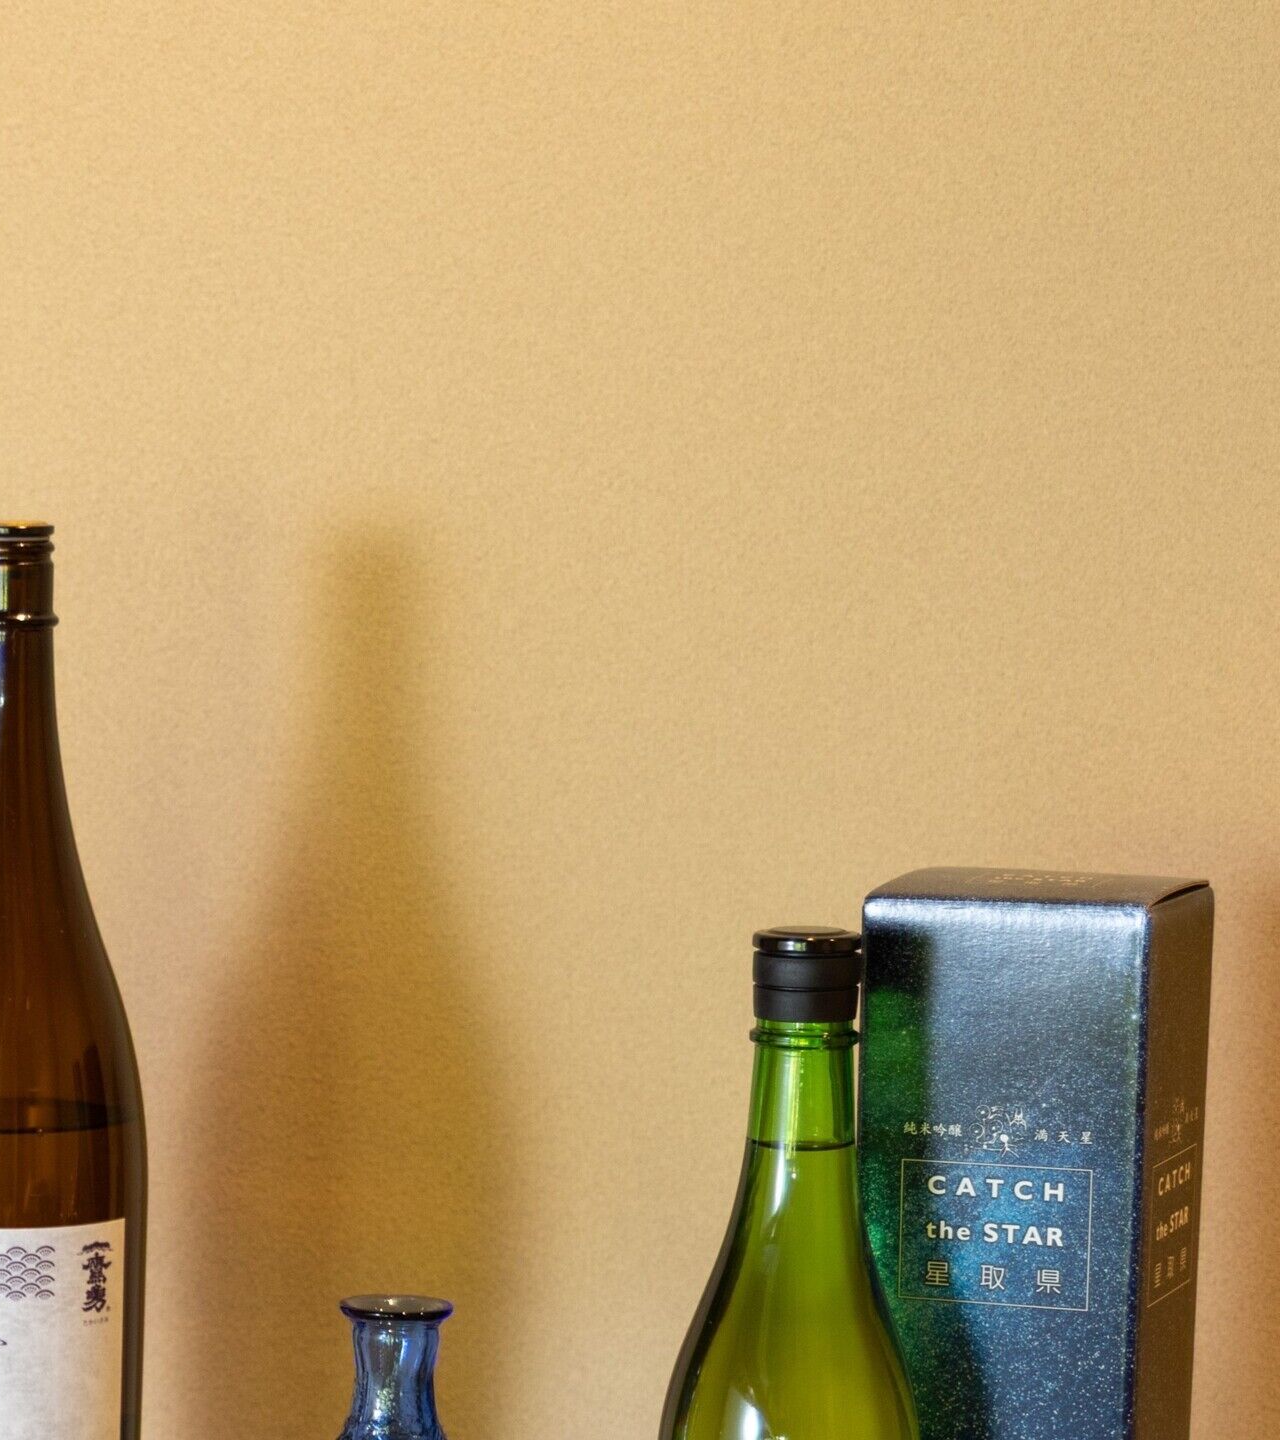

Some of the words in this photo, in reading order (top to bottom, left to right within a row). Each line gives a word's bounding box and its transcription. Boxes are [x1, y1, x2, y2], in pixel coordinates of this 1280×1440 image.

[1033, 1128, 1093, 1145] 満天星
[927, 1175, 1065, 1203] CATCH
[1158, 1161, 1192, 1197] CATCH
[926, 1220, 971, 1242] the
[983, 1223, 1064, 1248] STAR
[1156, 1221, 1169, 1242] the
[1169, 1205, 1190, 1234] STAR
[924, 1260, 1062, 1295] 星取県
